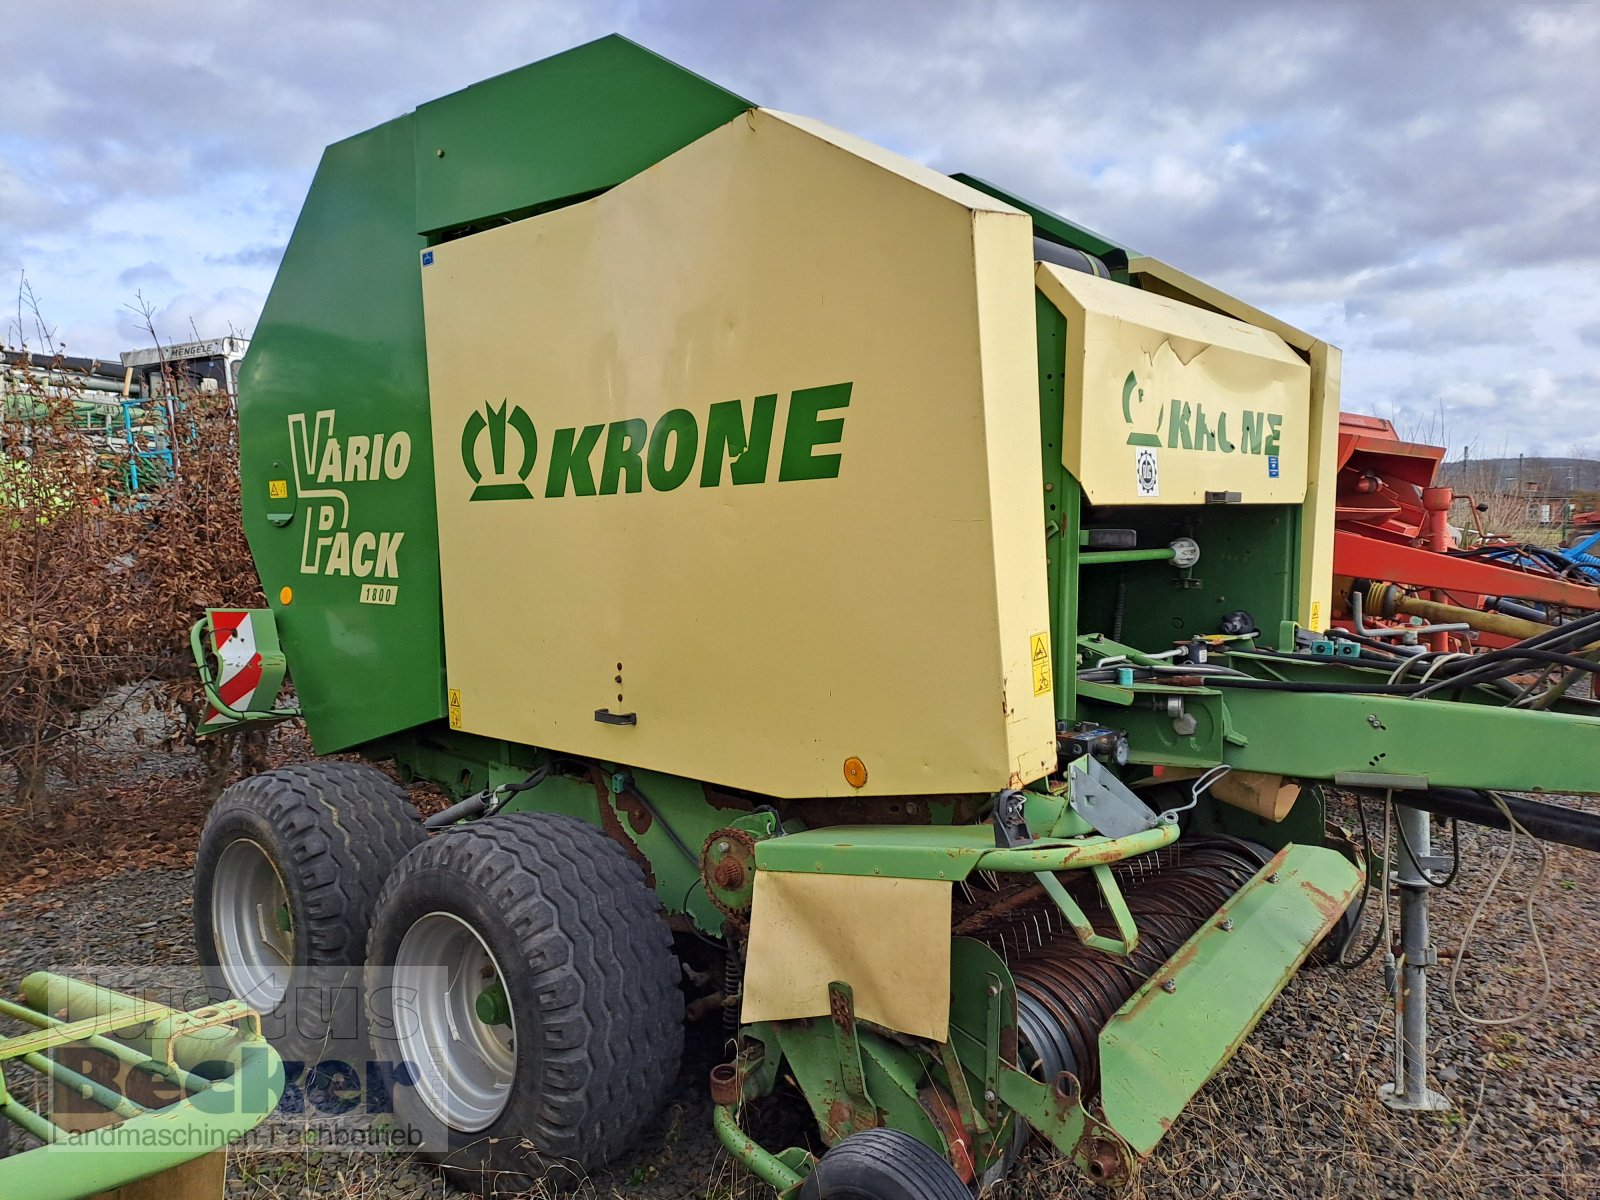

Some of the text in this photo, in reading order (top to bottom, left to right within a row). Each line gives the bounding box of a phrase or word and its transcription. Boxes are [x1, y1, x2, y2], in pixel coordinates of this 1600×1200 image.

[170, 344, 213, 357] MENGELE
[288, 409, 411, 485] VARIO
[544, 382, 853, 498] KRONE
[300, 489, 404, 578] PACK
[365, 587, 391, 602] 1800
